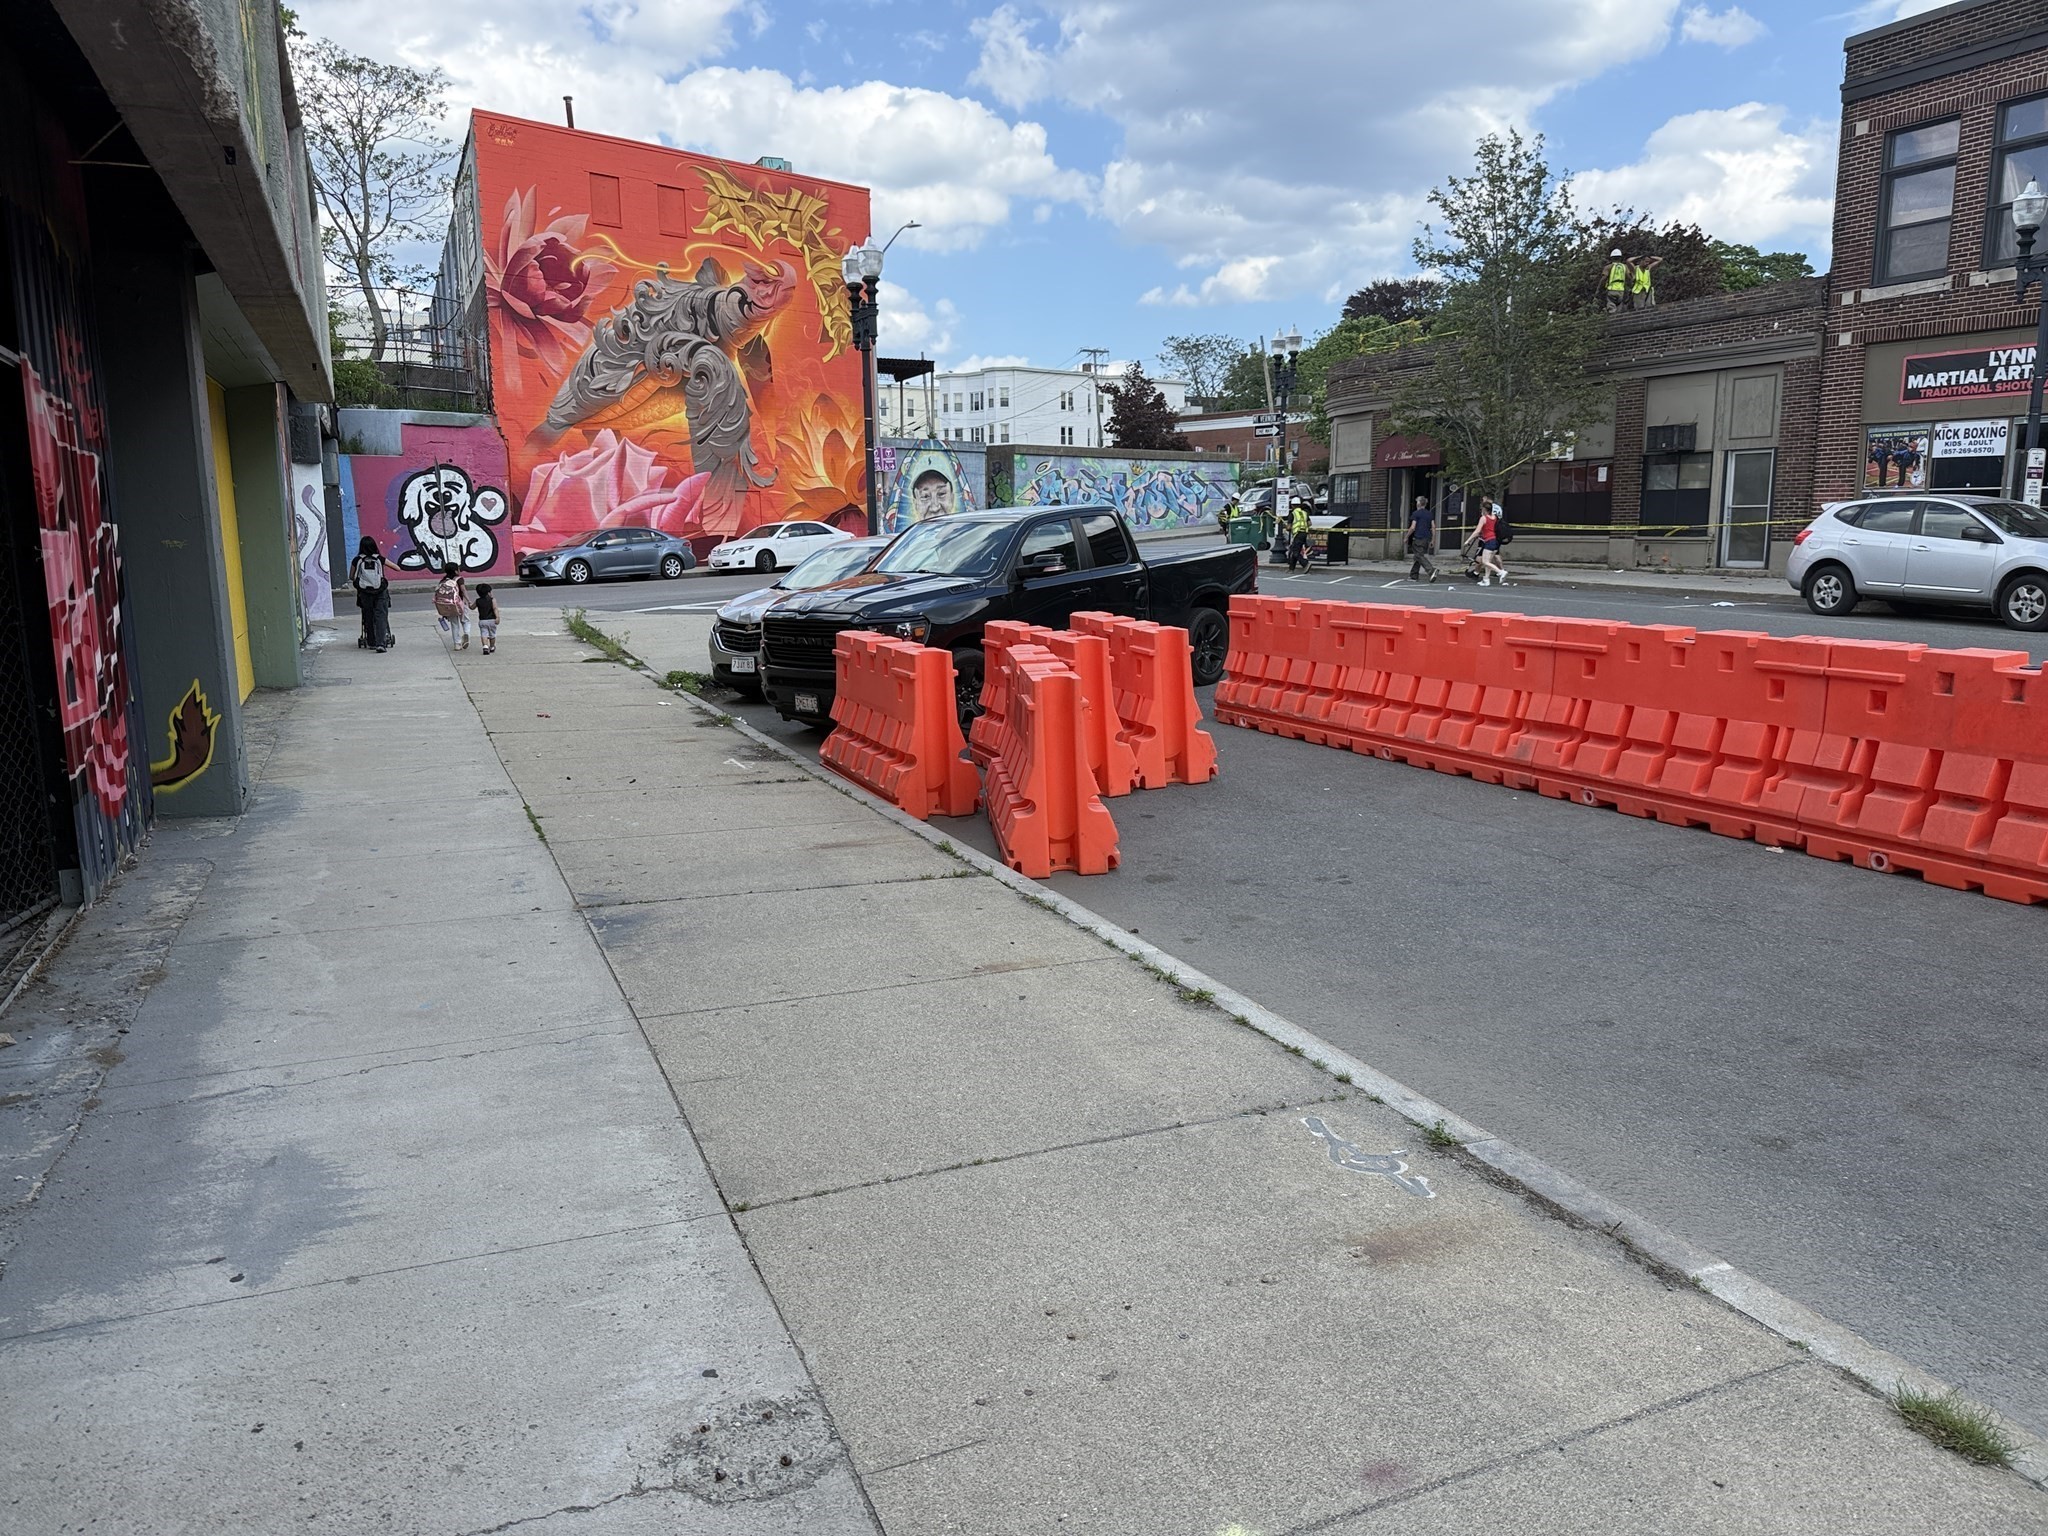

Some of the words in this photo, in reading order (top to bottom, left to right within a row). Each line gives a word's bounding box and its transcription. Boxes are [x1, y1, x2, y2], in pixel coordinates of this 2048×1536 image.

[1907, 368, 1989, 389] MARTIAL
[1992, 364, 2035, 382] ART
[1920, 384, 1992, 398] TRADITIONAL
[1260, 414, 1277, 422] VERNON
[1934, 428, 1960, 441] KICK
[1963, 426, 2007, 439] BOXING
